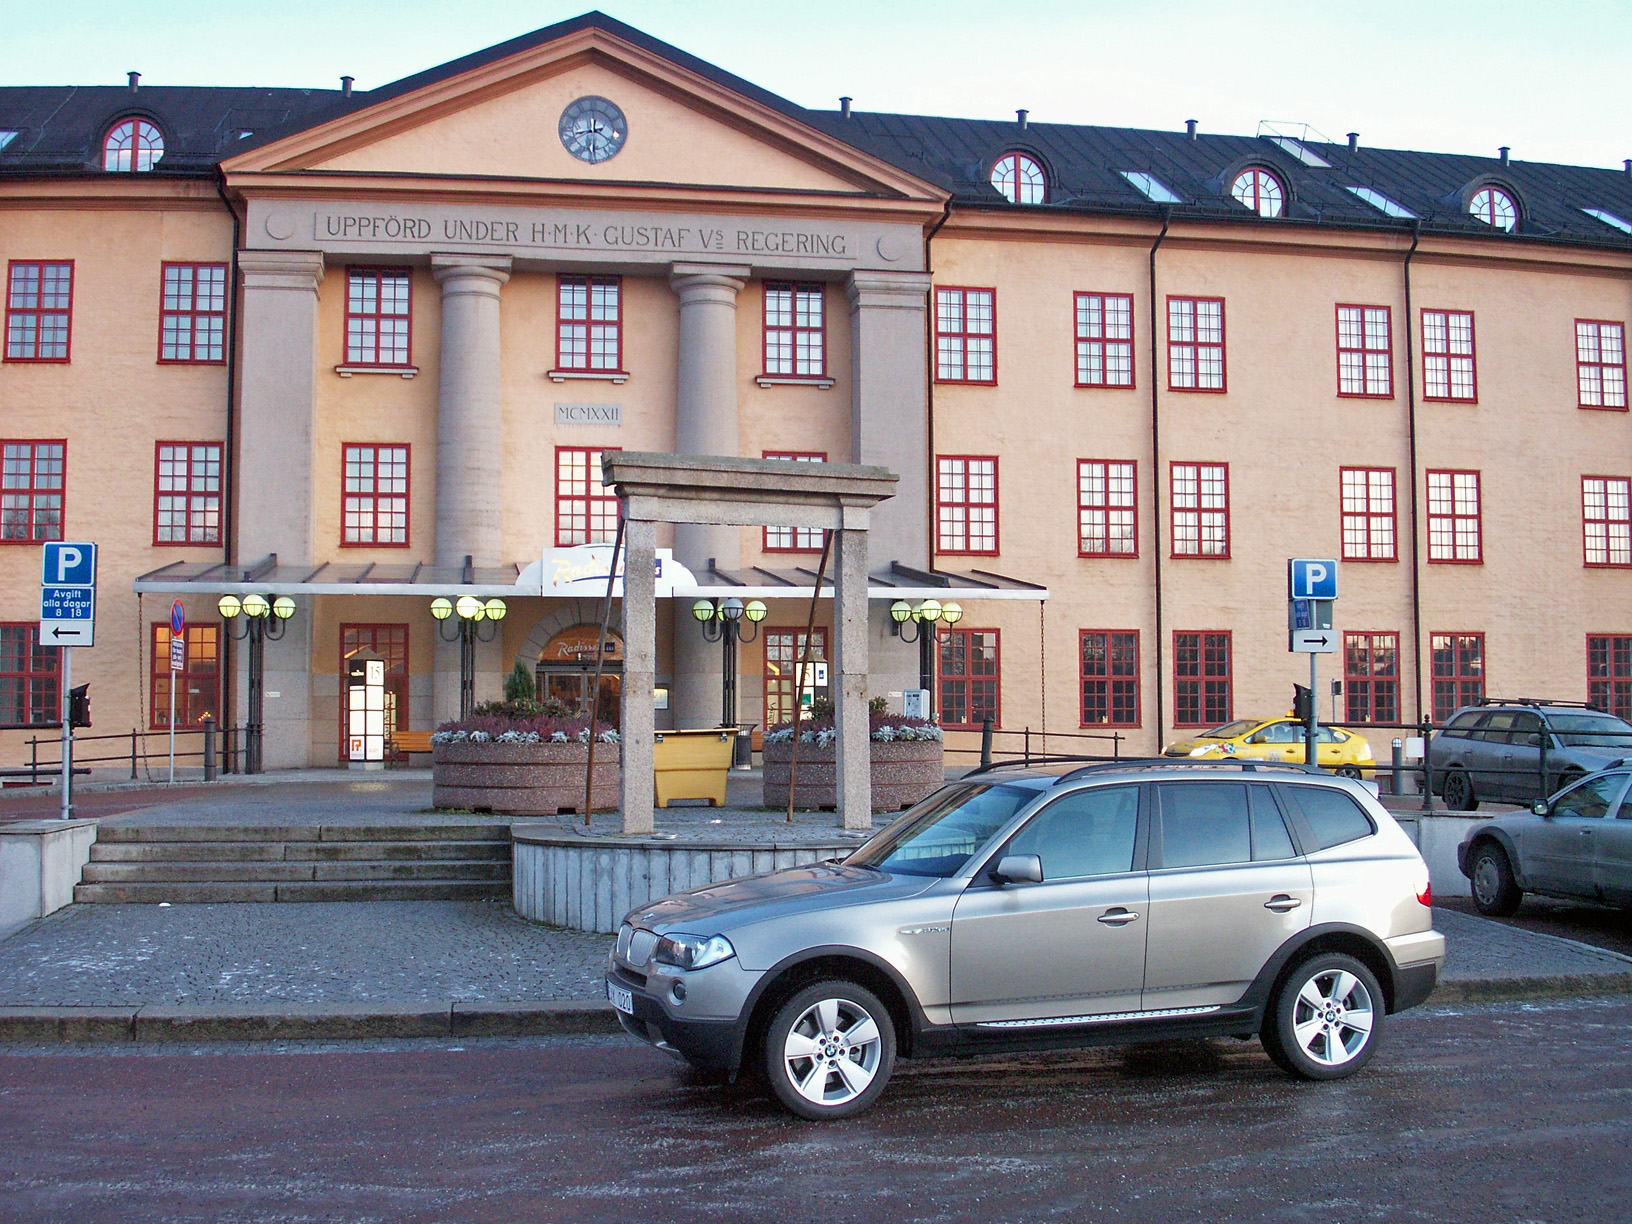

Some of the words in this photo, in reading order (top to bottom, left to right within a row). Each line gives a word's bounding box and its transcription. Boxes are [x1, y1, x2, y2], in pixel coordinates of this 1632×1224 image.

[327, 215, 431, 239] UPPFÖRD
[443, 219, 519, 242] UNDER
[603, 225, 691, 248] GUSTAF
[736, 230, 846, 255] REGERING
[558, 407, 619, 421] MCMXXII
[57, 546, 83, 582] P
[1305, 563, 1327, 595] P
[43, 599, 60, 607] alla
[63, 599, 91, 609] dagar
[53, 589, 81, 599] Avgift
